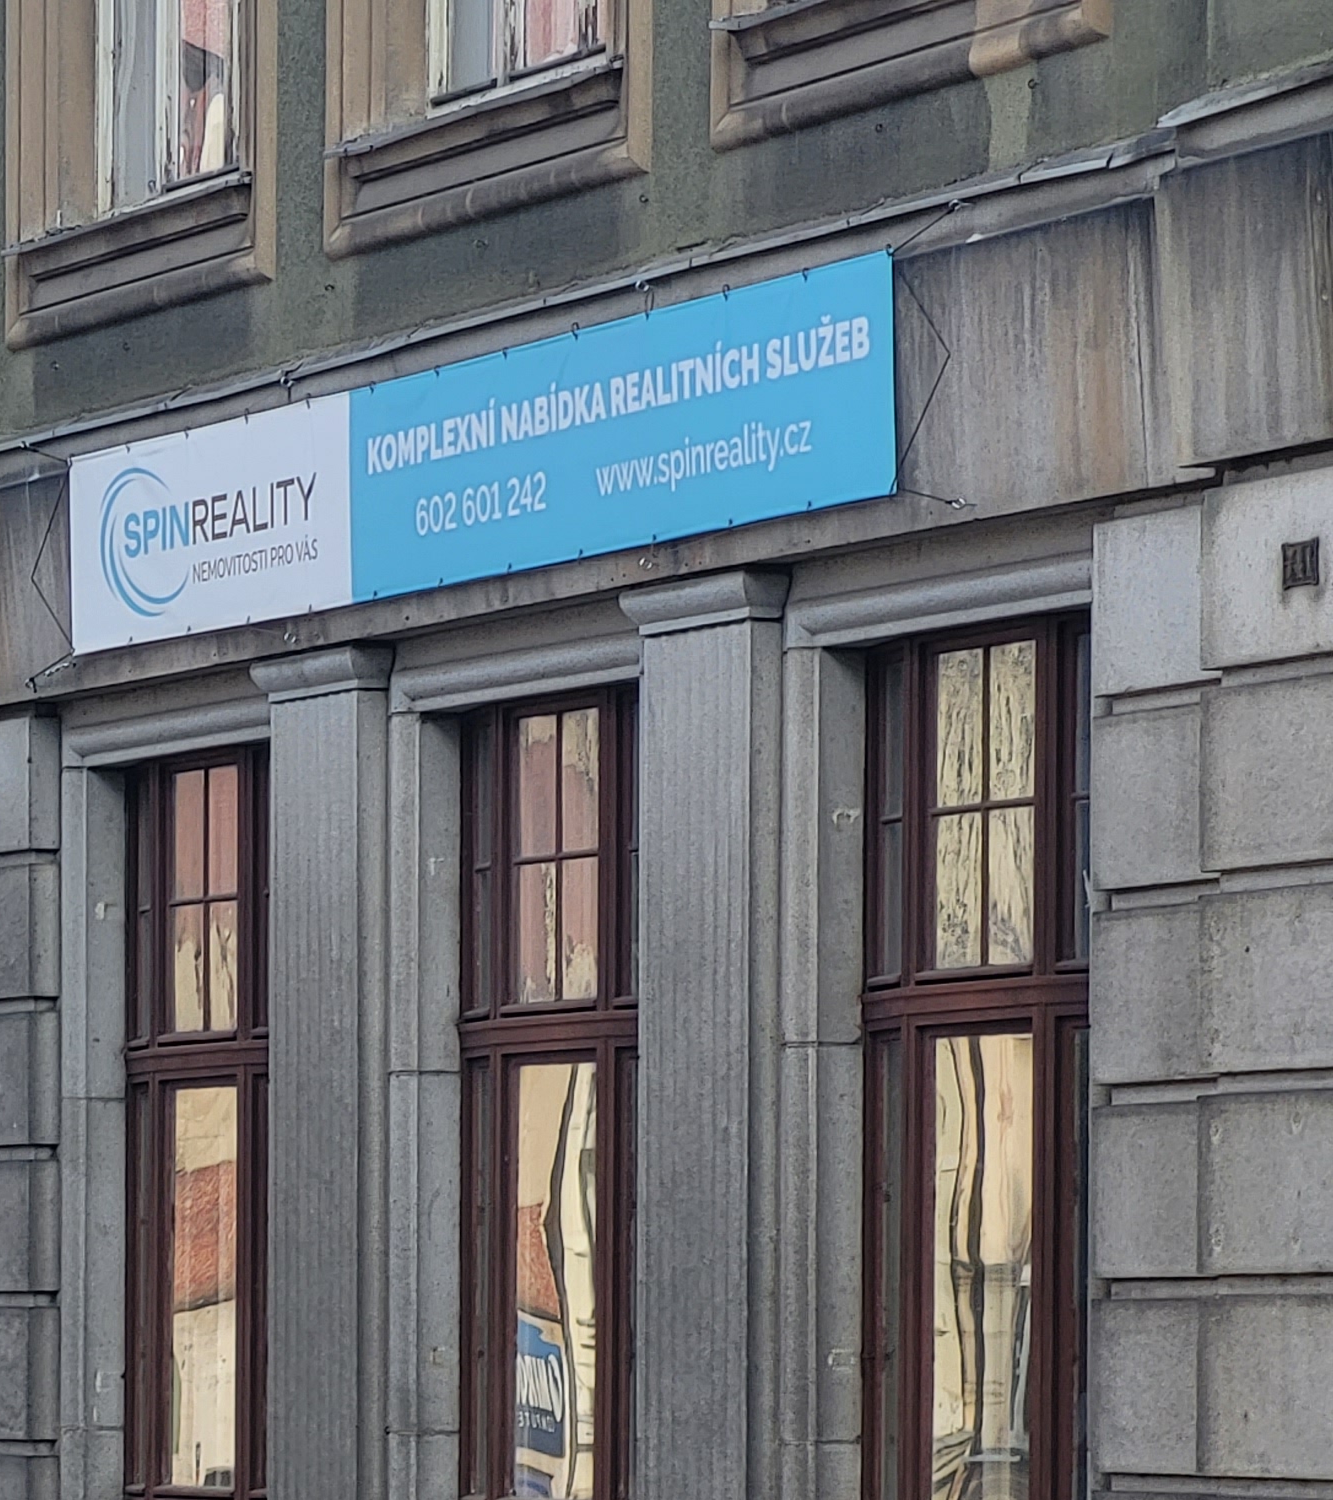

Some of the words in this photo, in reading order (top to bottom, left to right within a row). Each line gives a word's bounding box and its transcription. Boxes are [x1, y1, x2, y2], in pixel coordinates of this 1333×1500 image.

[367, 398, 496, 475] KOMPLEXNÍ
[501, 382, 606, 444] NABÍDKA
[610, 341, 760, 416] REALITNÍCH
[766, 315, 870, 381] SLUŽEB
[596, 419, 811, 497] www.spinreality.cz
[124, 472, 317, 558] SPINREALITY
[415, 491, 457, 536] 602
[462, 482, 501, 527] 601
[507, 472, 547, 518] 242
[192, 549, 268, 584] NEMOVITOSTI
[270, 543, 293, 569] PRO
[295, 534, 318, 562] VÁS
